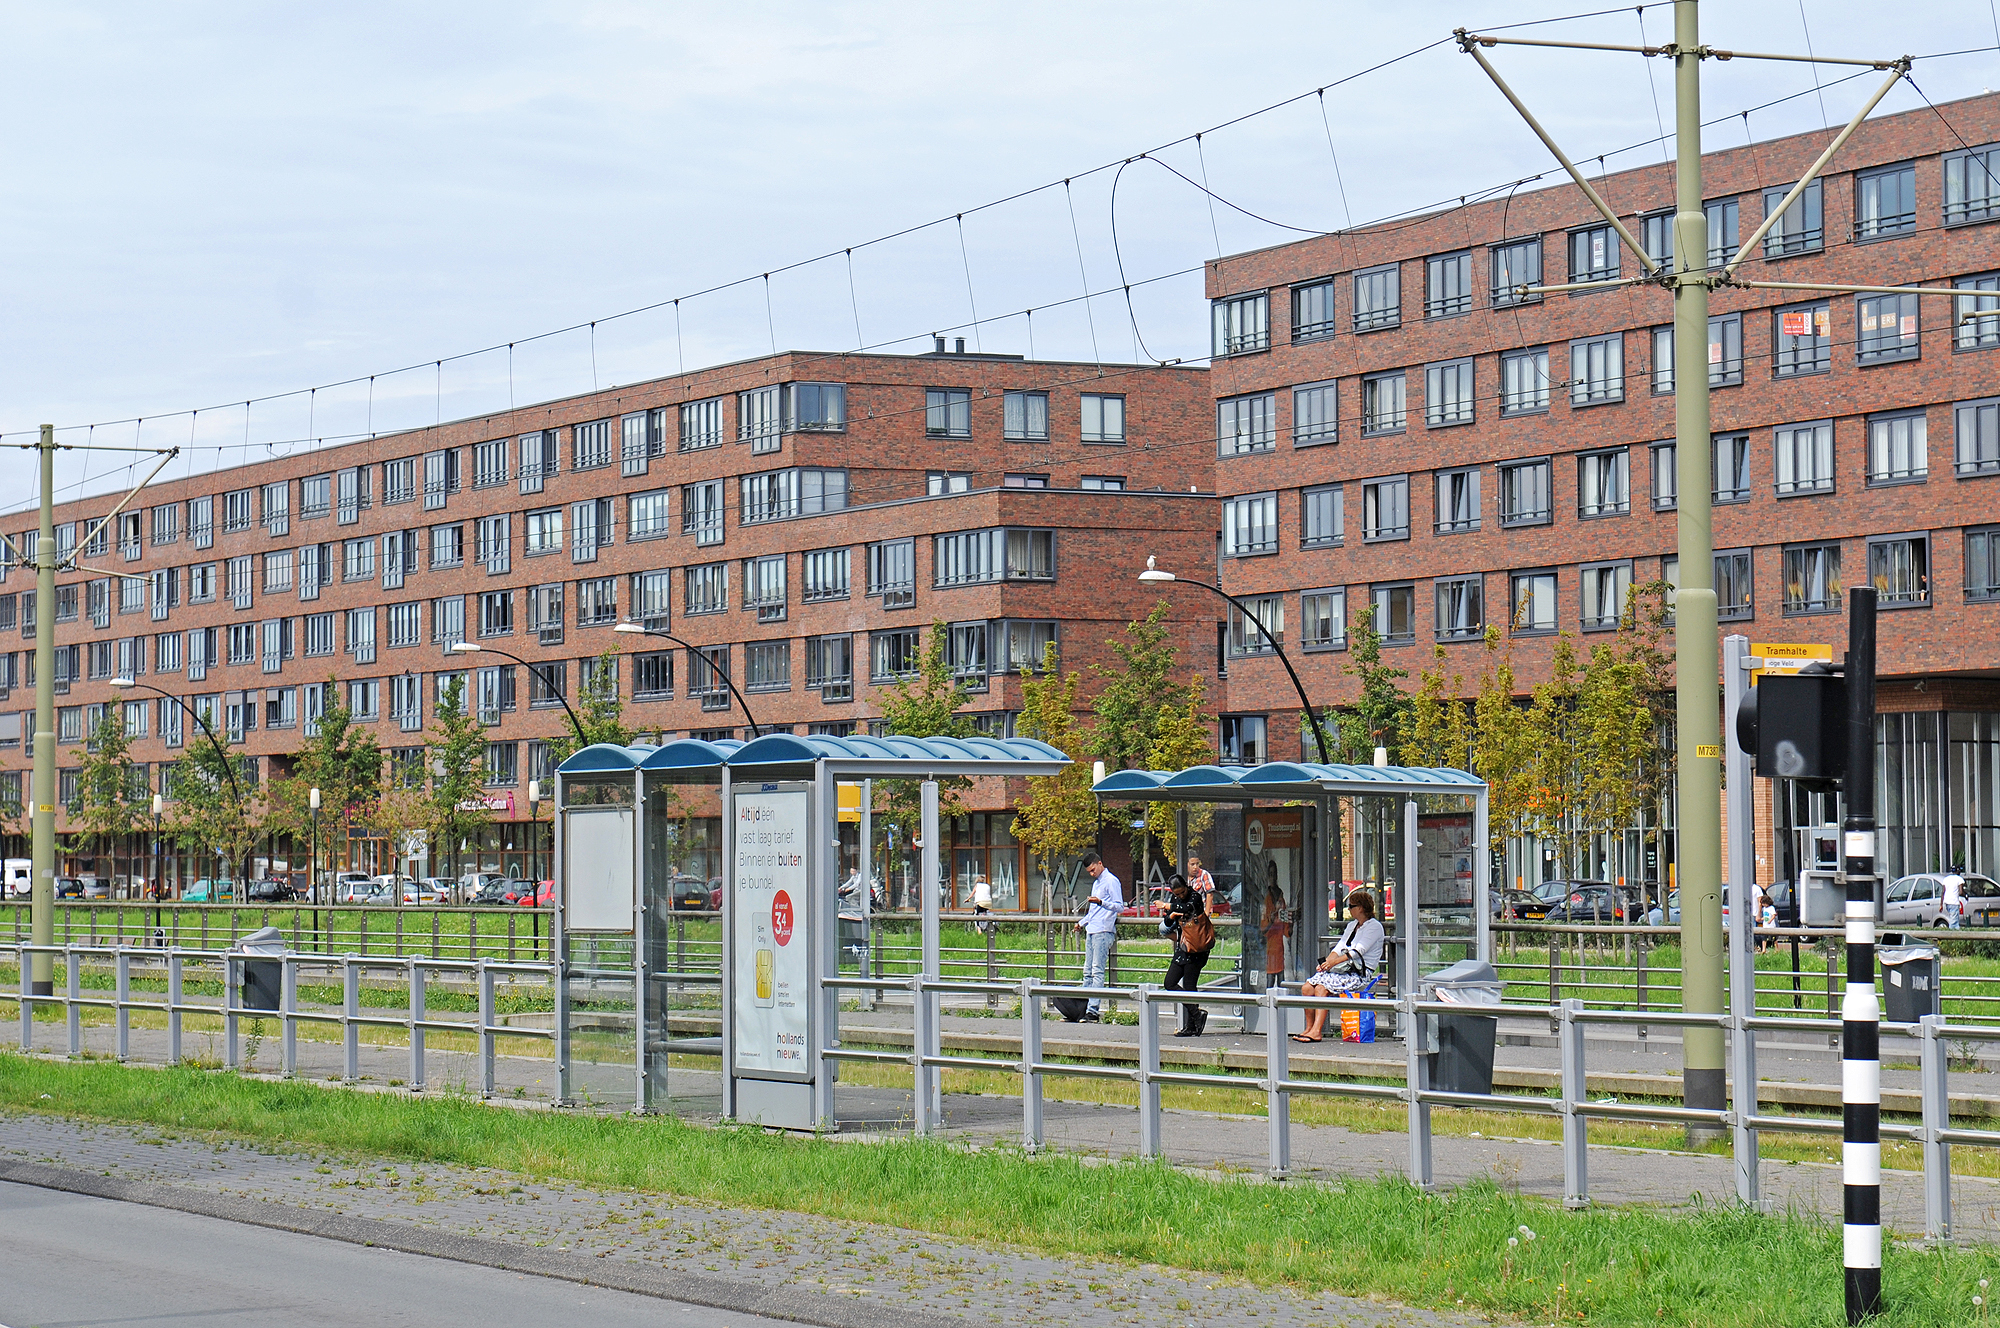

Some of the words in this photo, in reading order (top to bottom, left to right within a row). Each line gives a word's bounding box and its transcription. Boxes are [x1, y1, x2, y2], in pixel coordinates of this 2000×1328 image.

[1766, 647, 1808, 655] Tramhalte
[740, 807, 760, 824] Altijd
[762, 806, 775, 821] één
[740, 830, 756, 844] vast
[758, 829, 772, 846] laag
[774, 828, 795, 844] tarief.
[740, 852, 765, 867] Binnen
[778, 852, 802, 867] buiten
[739, 874, 746, 892] je
[748, 874, 775, 890] bundel.
[757, 936, 767, 944] Only
[776, 1032, 805, 1046] hollands
